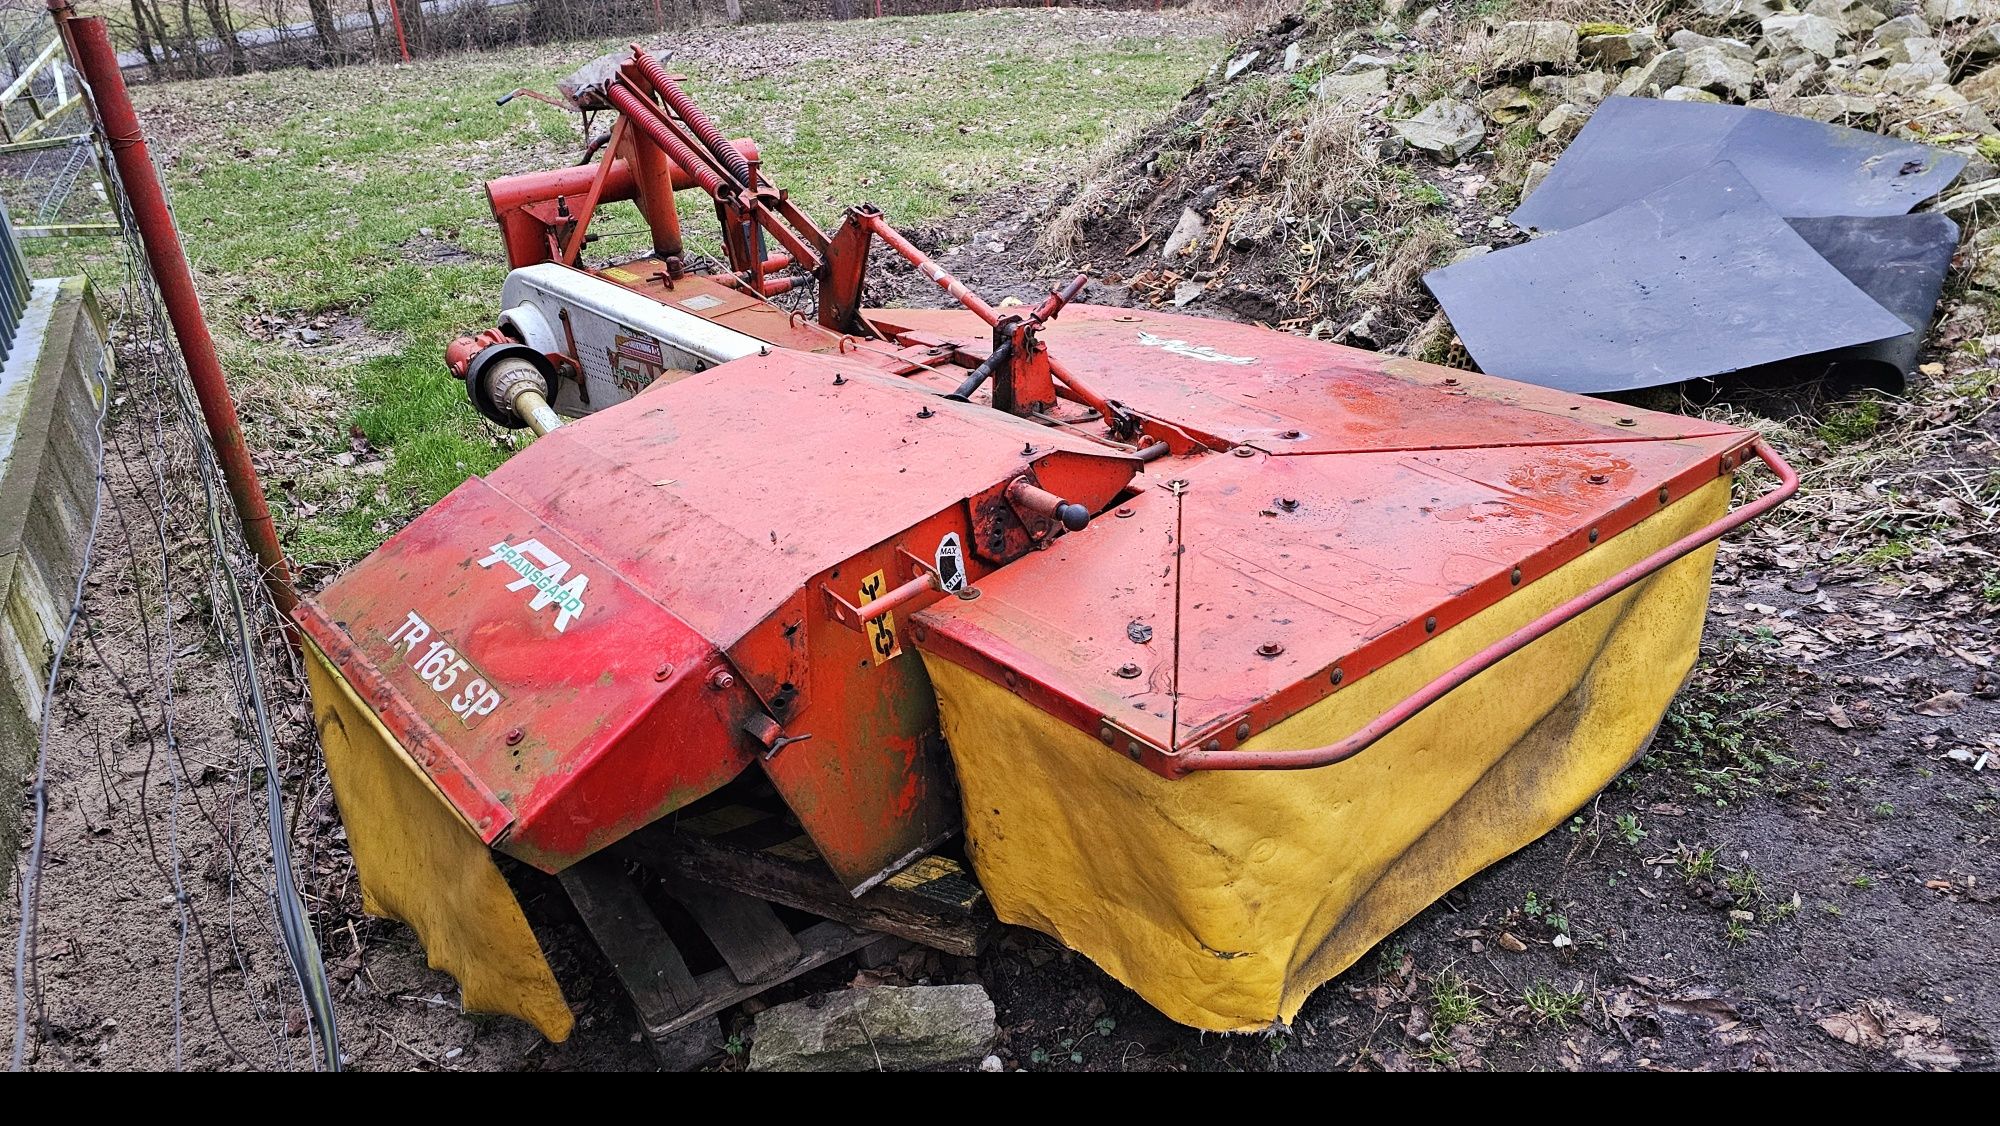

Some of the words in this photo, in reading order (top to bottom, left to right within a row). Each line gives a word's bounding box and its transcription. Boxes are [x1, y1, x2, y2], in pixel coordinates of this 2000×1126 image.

[940, 547, 957, 555] MAX
[495, 544, 580, 612] FRANSGARD
[945, 572, 962, 590] MIN
[388, 611, 430, 656] TR
[413, 640, 470, 692] 165
[451, 678, 500, 720] SP
